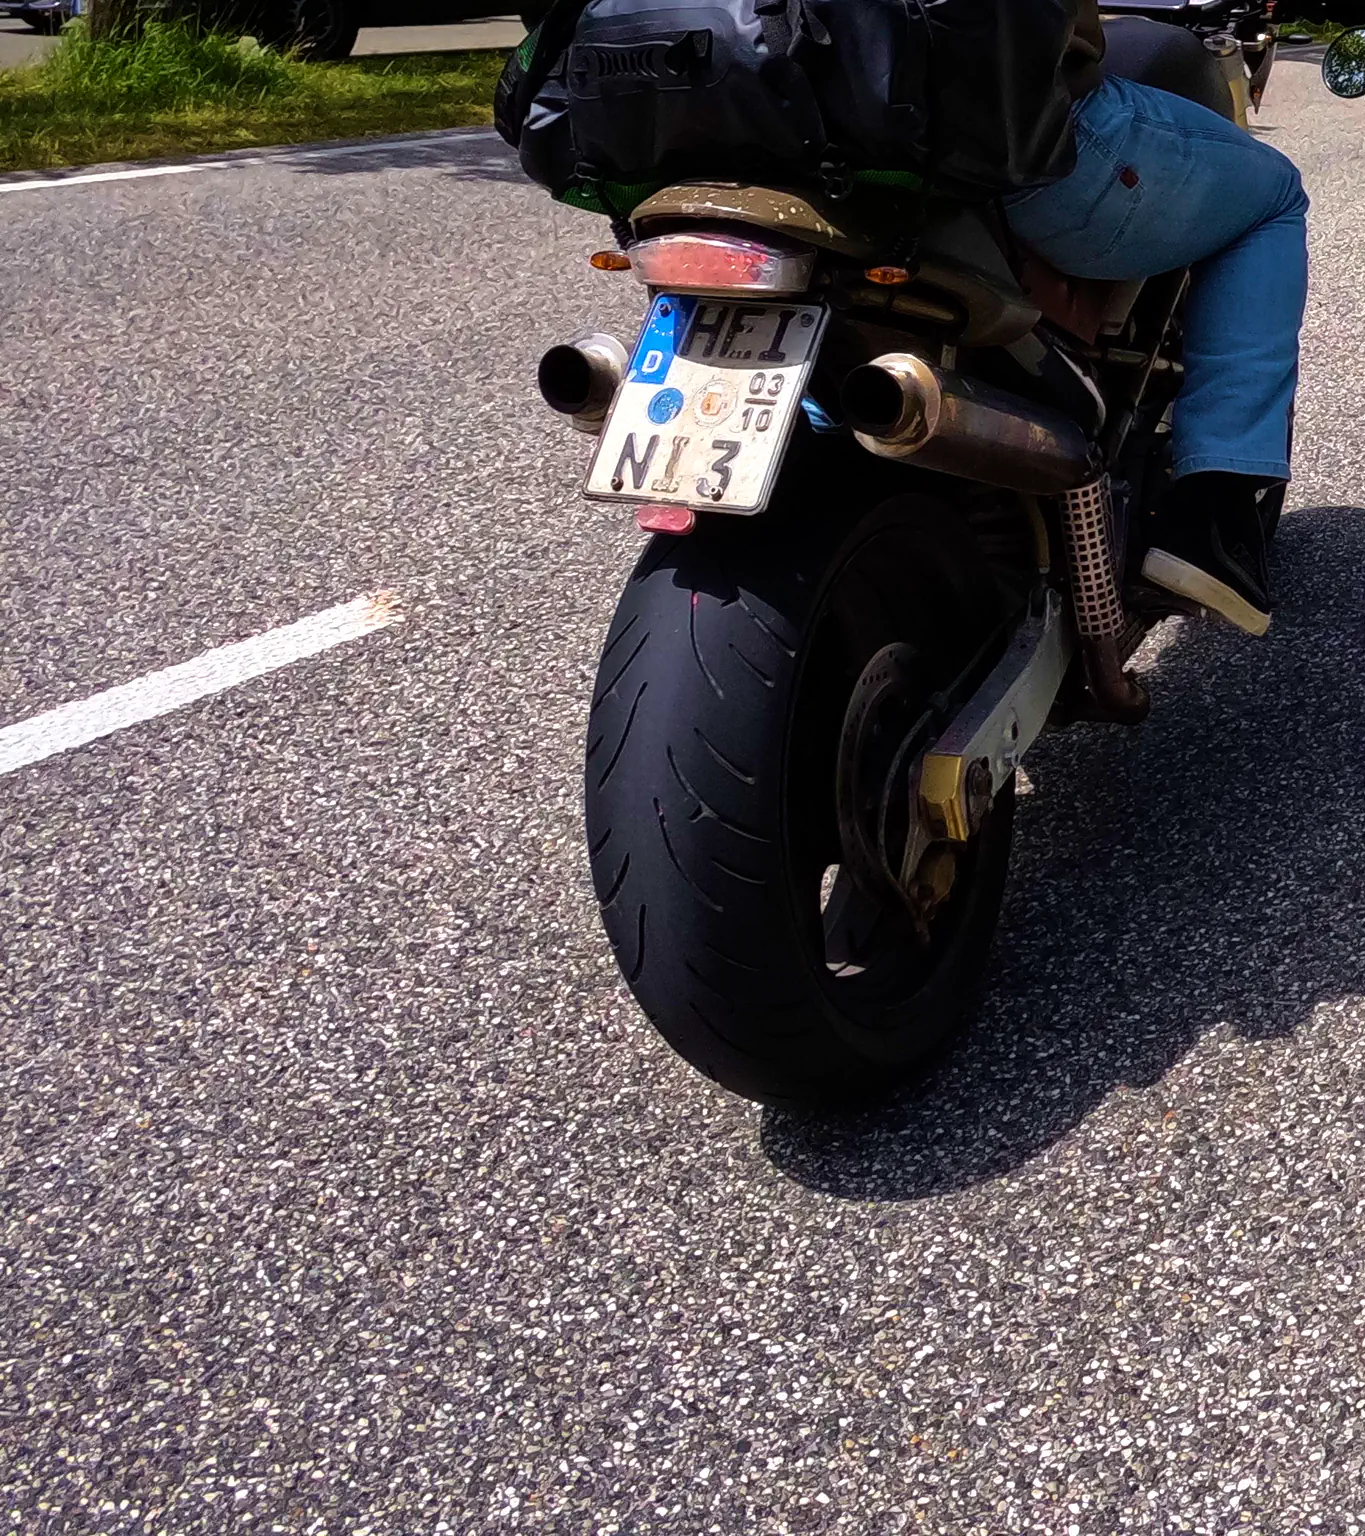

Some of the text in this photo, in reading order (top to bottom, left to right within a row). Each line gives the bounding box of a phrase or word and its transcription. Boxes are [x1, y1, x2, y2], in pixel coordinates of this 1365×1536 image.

[641, 349, 663, 374] D
[749, 372, 785, 396] 03
[741, 407, 774, 432] 10
